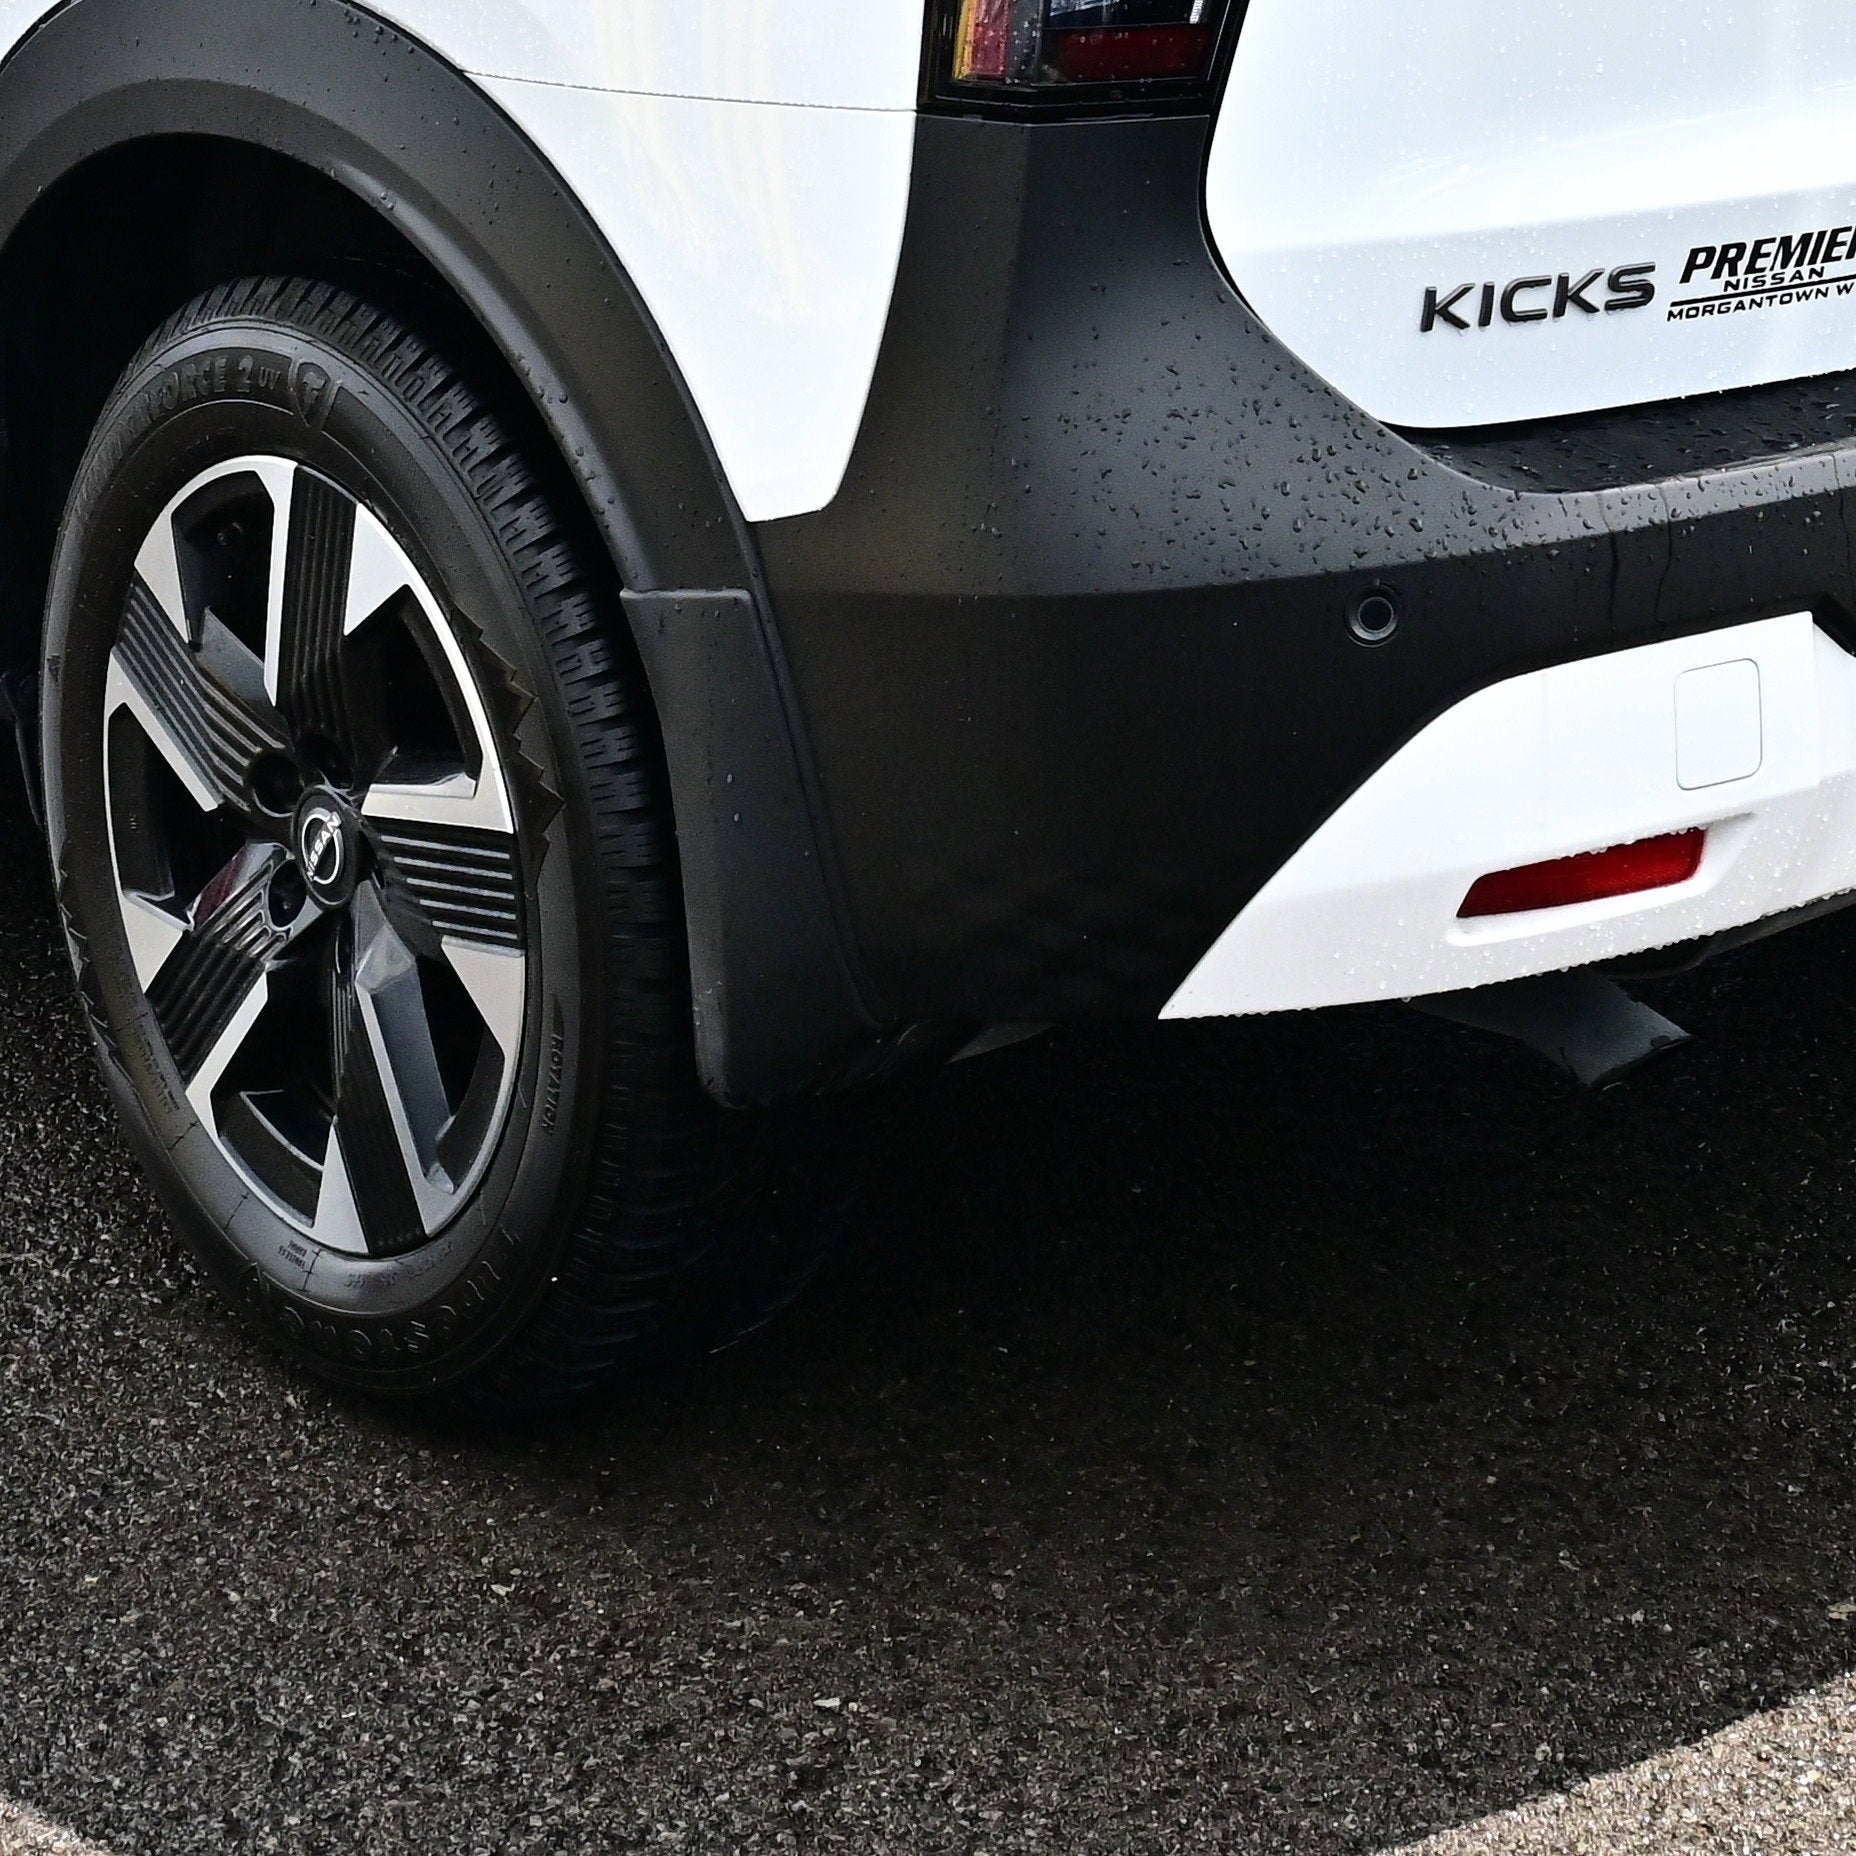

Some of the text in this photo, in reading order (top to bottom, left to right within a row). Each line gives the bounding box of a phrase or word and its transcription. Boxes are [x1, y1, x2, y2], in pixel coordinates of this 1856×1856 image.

[1419, 260, 1656, 334] KICKS
[1666, 286, 1830, 322] MORGANTOWN
[1723, 266, 1825, 293] NISSAN
[306, 811, 342, 883] NISSAN
